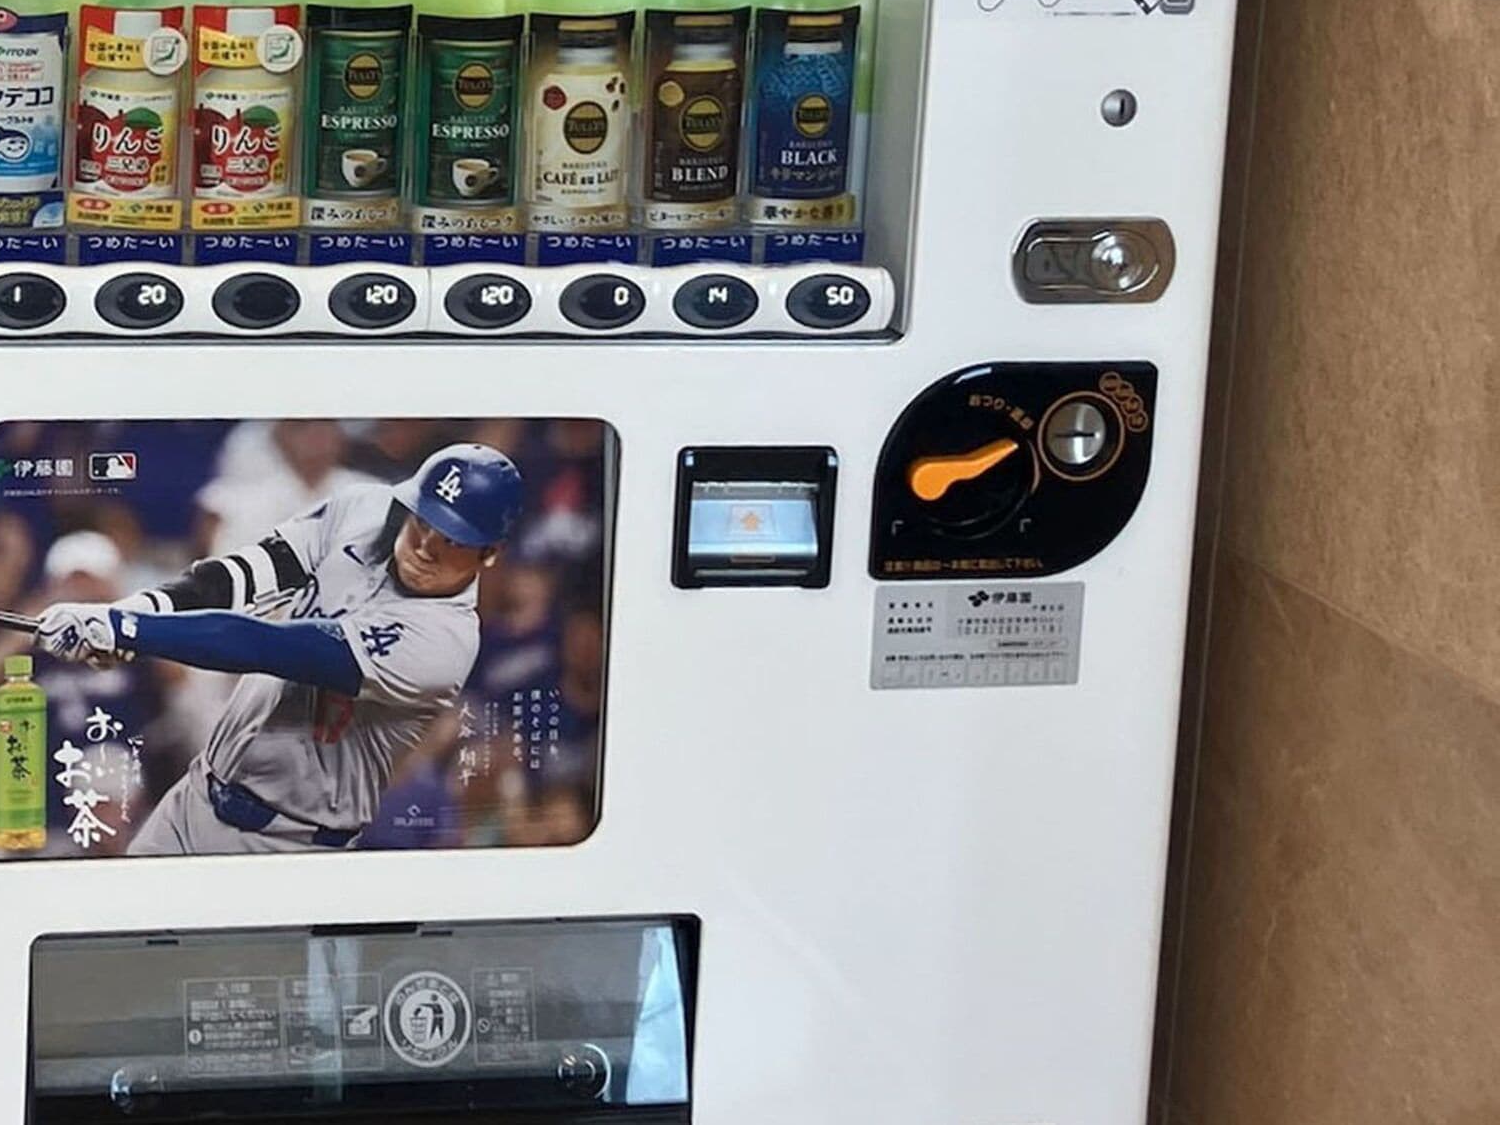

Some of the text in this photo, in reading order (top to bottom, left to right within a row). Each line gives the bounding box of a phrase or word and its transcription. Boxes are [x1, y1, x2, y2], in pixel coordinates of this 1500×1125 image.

[5, 47, 24, 57] ITO
[321, 114, 398, 130] ESPRESSO
[92, 124, 164, 153] りんご
[211, 126, 281, 153] りんご
[432, 124, 510, 139] ESPRESSO
[104, 157, 149, 174] 三兄弟
[225, 157, 269, 174] 三兄弟
[781, 149, 837, 166] BLACK
[543, 171, 577, 186] CAFÉ
[671, 166, 729, 183] BLEND
[87, 236, 175, 250] つめた～い
[203, 235, 290, 249] つめた～い
[318, 235, 405, 249] つめた～い
[433, 234, 519, 249] つめた～い
[546, 234, 632, 249] つめた～い
[660, 235, 746, 250] つめた～い
[774, 233, 859, 247] つめた～い
[138, 285, 167, 305] 20
[366, 285, 399, 305] 120
[481, 287, 514, 305] 120
[13, 458, 74, 478] 伊藤園
[53, 739, 117, 849] お茶
